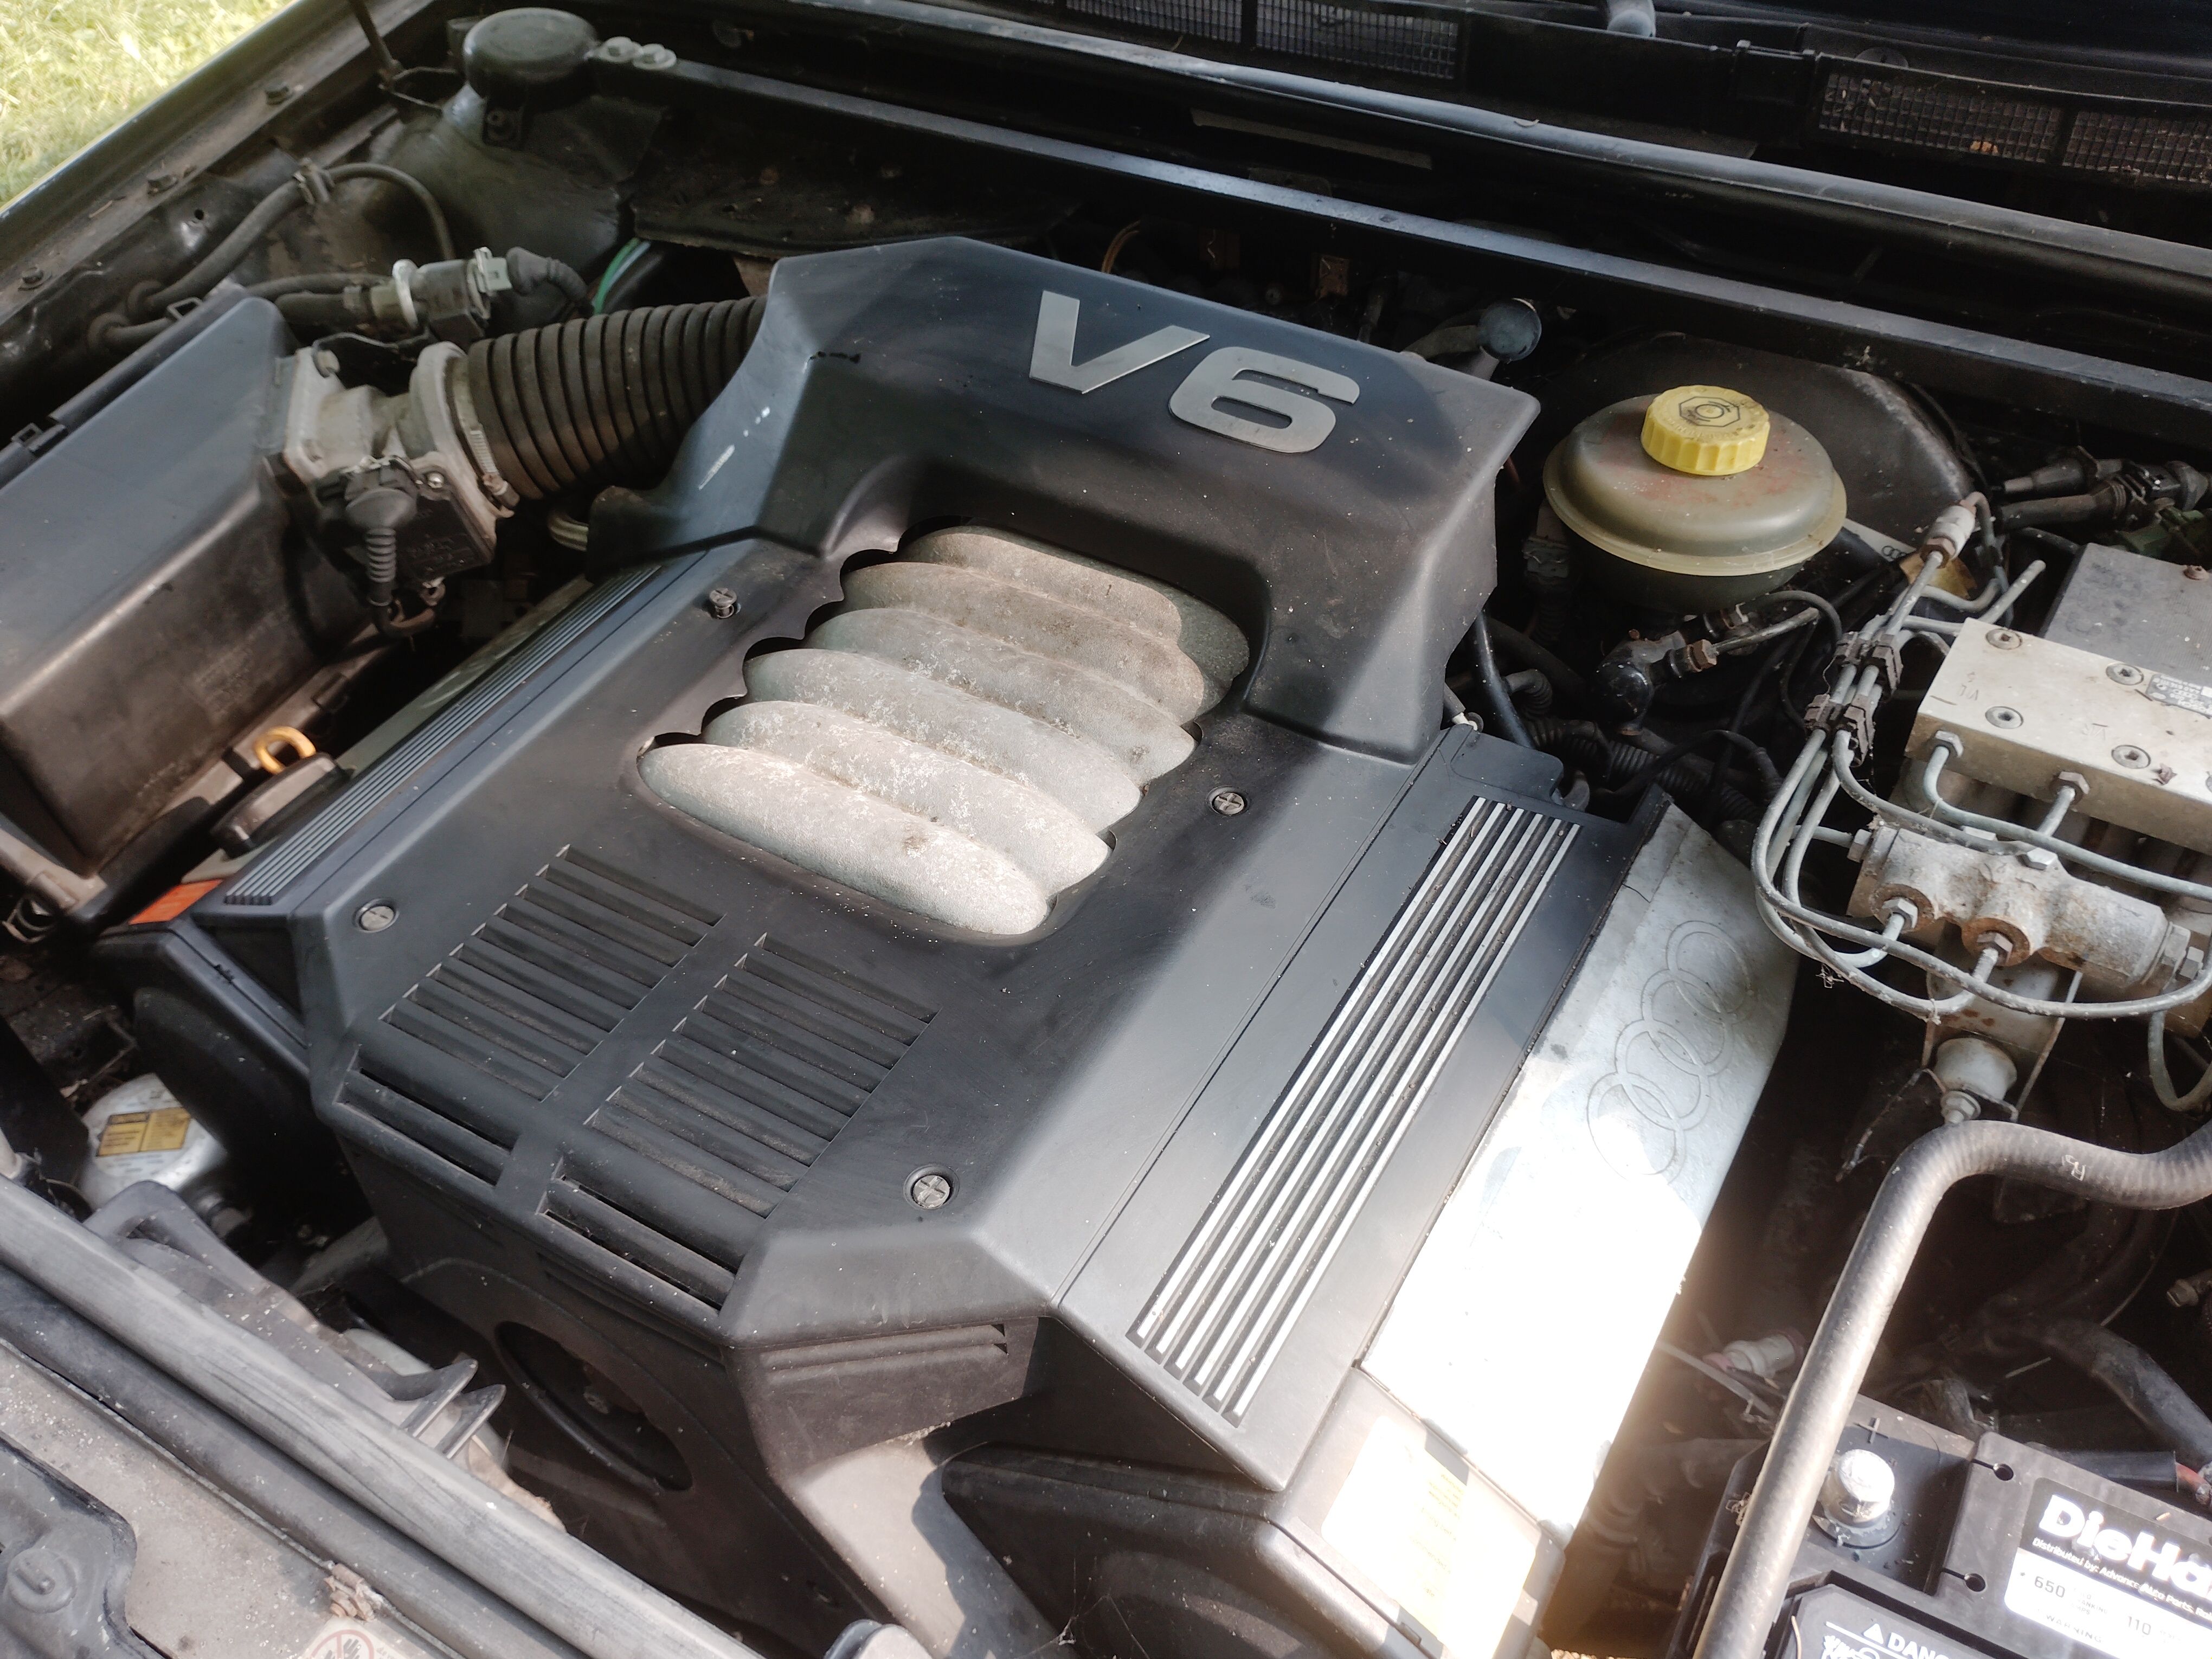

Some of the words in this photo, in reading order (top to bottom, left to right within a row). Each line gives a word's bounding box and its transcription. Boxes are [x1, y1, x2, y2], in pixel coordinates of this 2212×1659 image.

[1030, 291, 1360, 453] V6
[2032, 1537, 2085, 1566] Distributed
[2084, 1560, 2100, 1573] by:
[2099, 1567, 2140, 1589] Advance
[2140, 1582, 2166, 1600] Auto
[2039, 1494, 2212, 1603] DieHa
[2034, 1576, 2066, 1598] 650
[2127, 1615, 2151, 1635] 110
